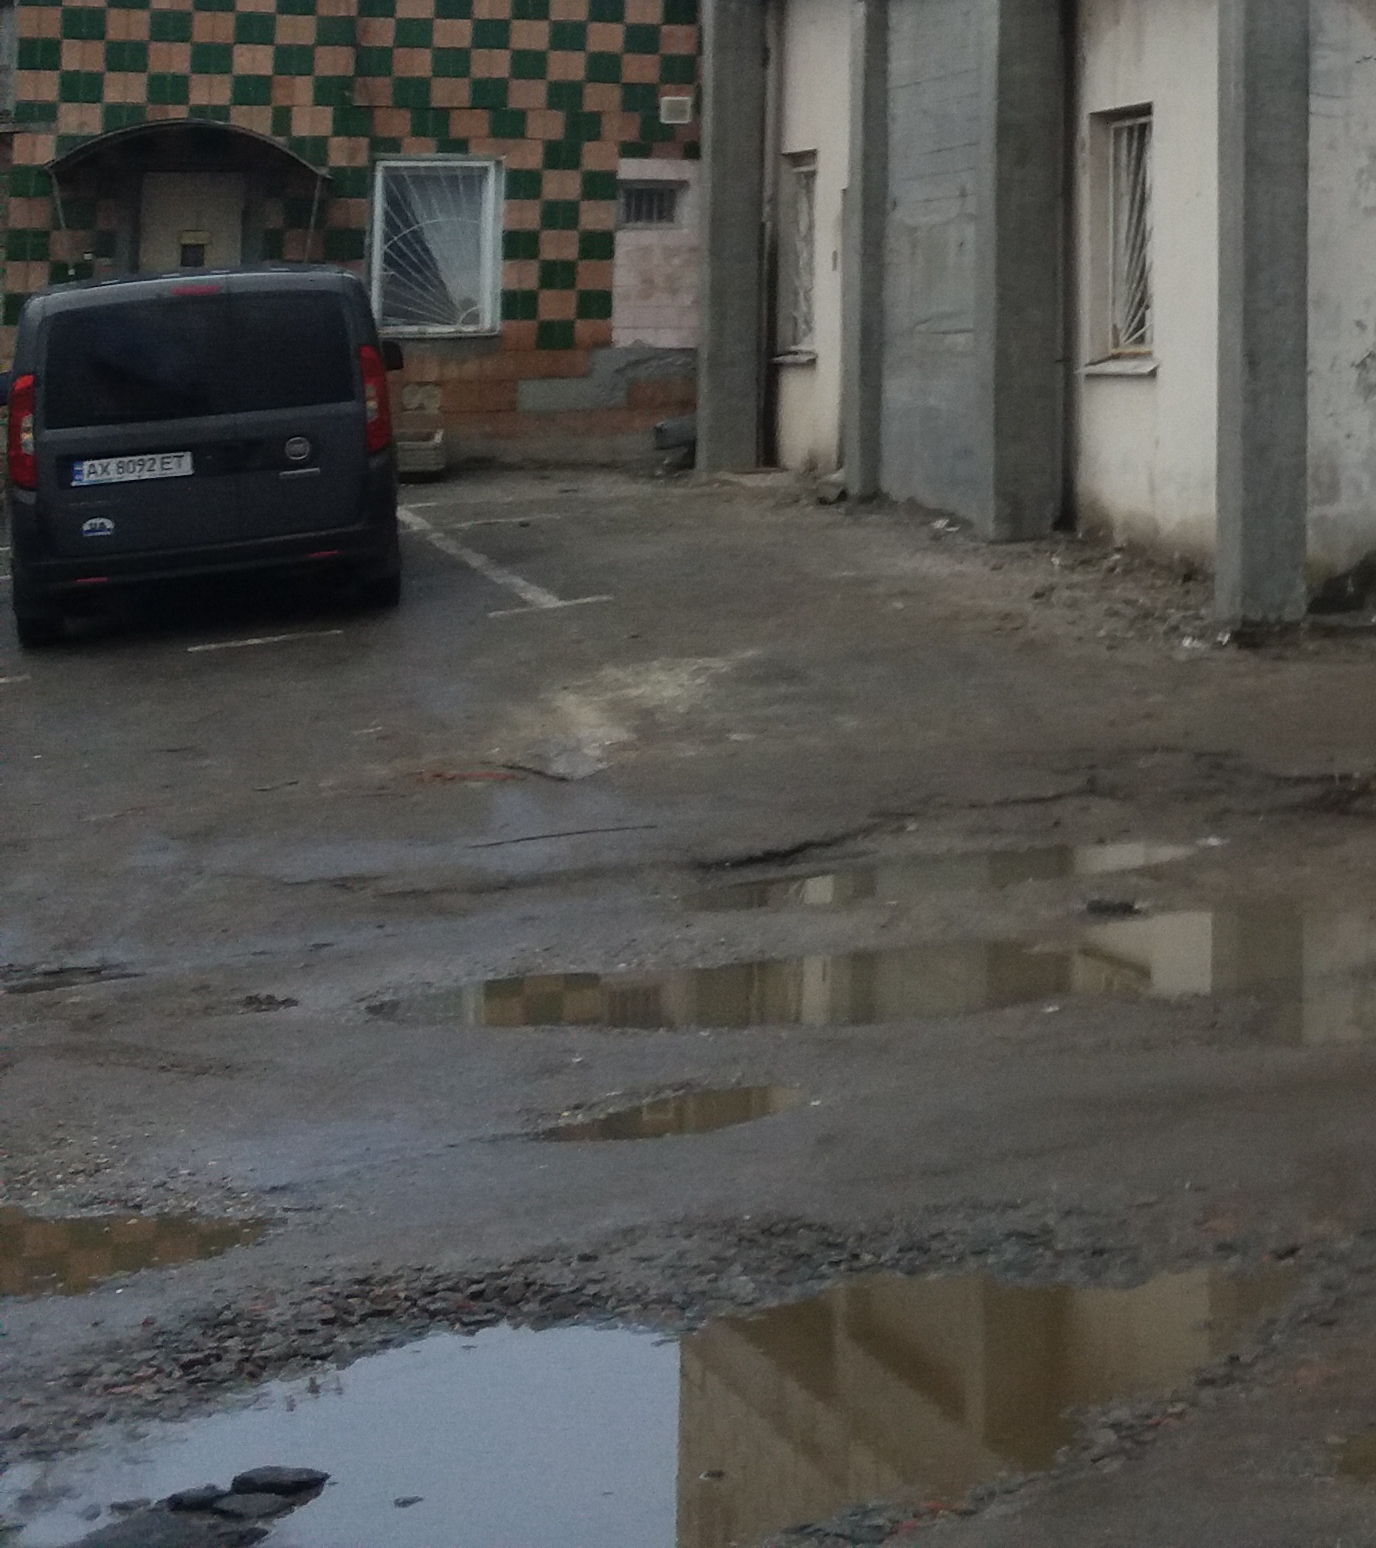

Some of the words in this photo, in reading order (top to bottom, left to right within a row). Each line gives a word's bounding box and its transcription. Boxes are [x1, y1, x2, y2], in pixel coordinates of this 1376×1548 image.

[87, 462, 111, 478] AX
[116, 457, 156, 474] 8092
[161, 454, 185, 472] ET
